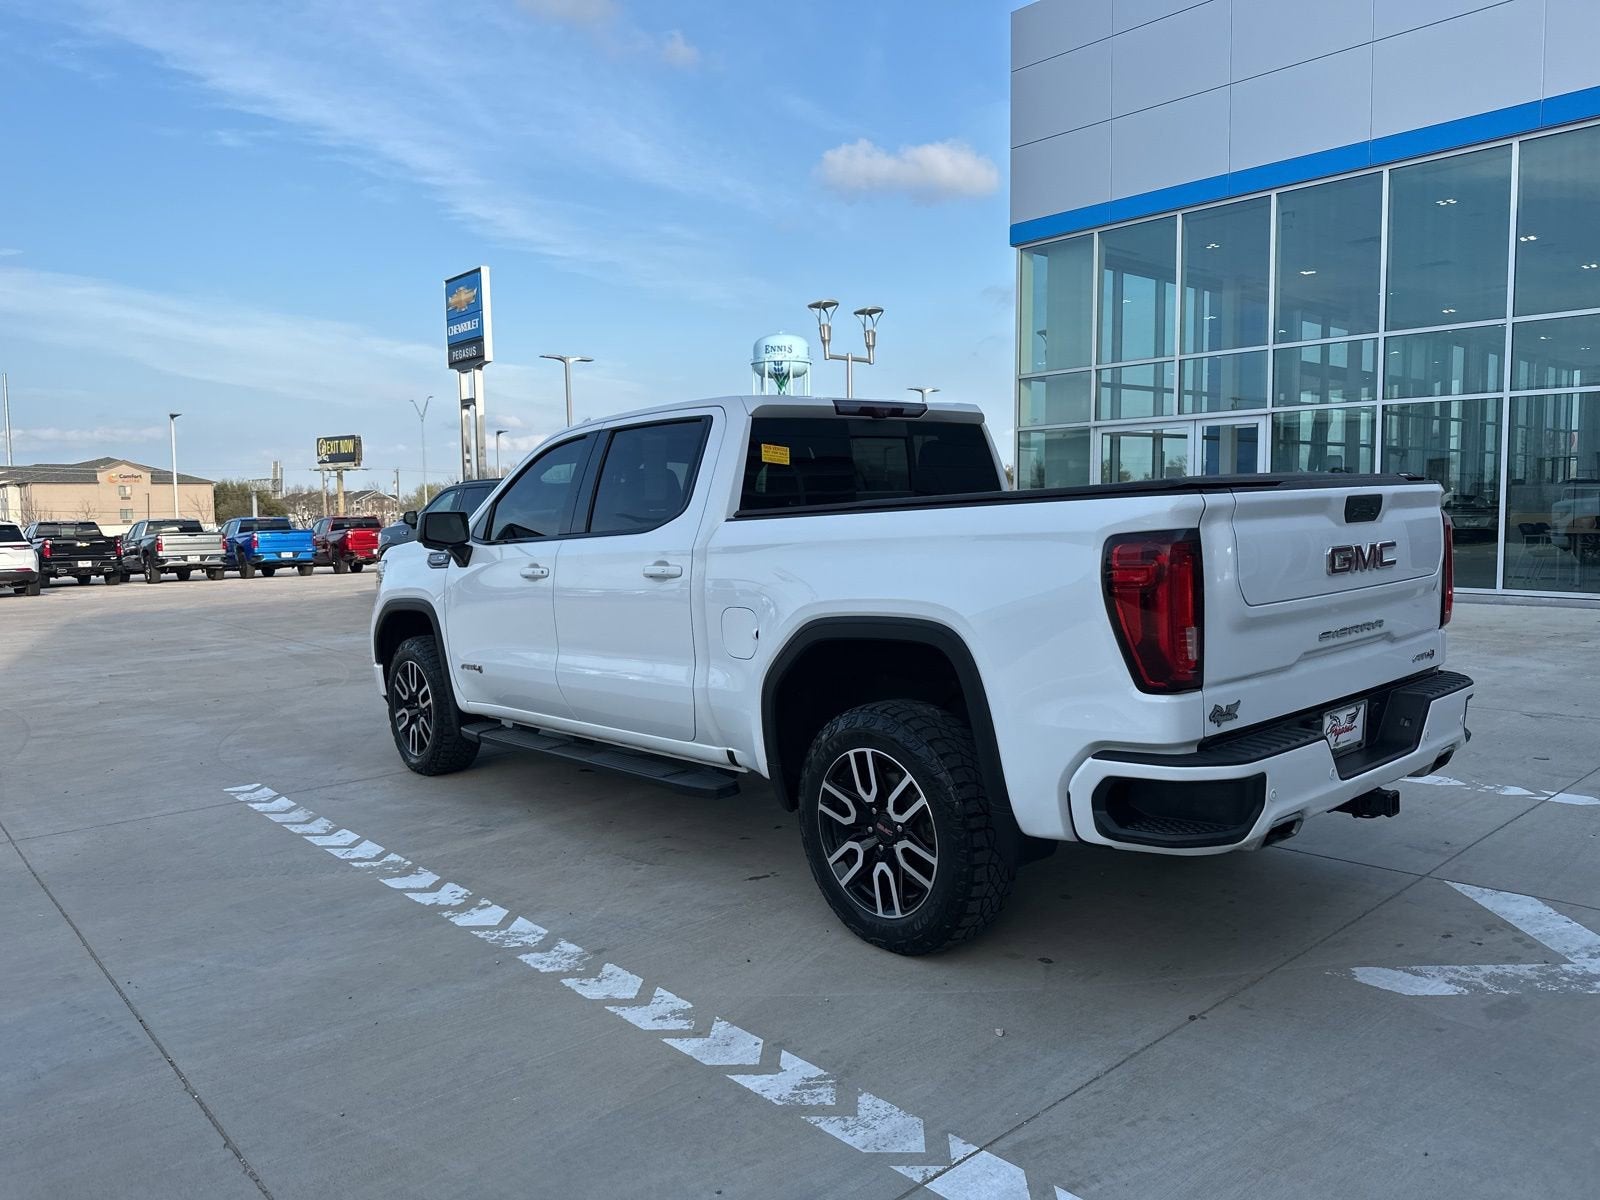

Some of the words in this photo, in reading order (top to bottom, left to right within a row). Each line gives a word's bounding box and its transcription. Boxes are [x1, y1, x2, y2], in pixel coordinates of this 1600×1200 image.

[448, 318, 479, 336] CHEVROLET
[452, 346, 477, 361] PEGASUS
[765, 344, 792, 354] ENNIS
[326, 440, 339, 454] EXIT
[1326, 540, 1397, 576] GMC
[1319, 619, 1384, 641] SIERRA
